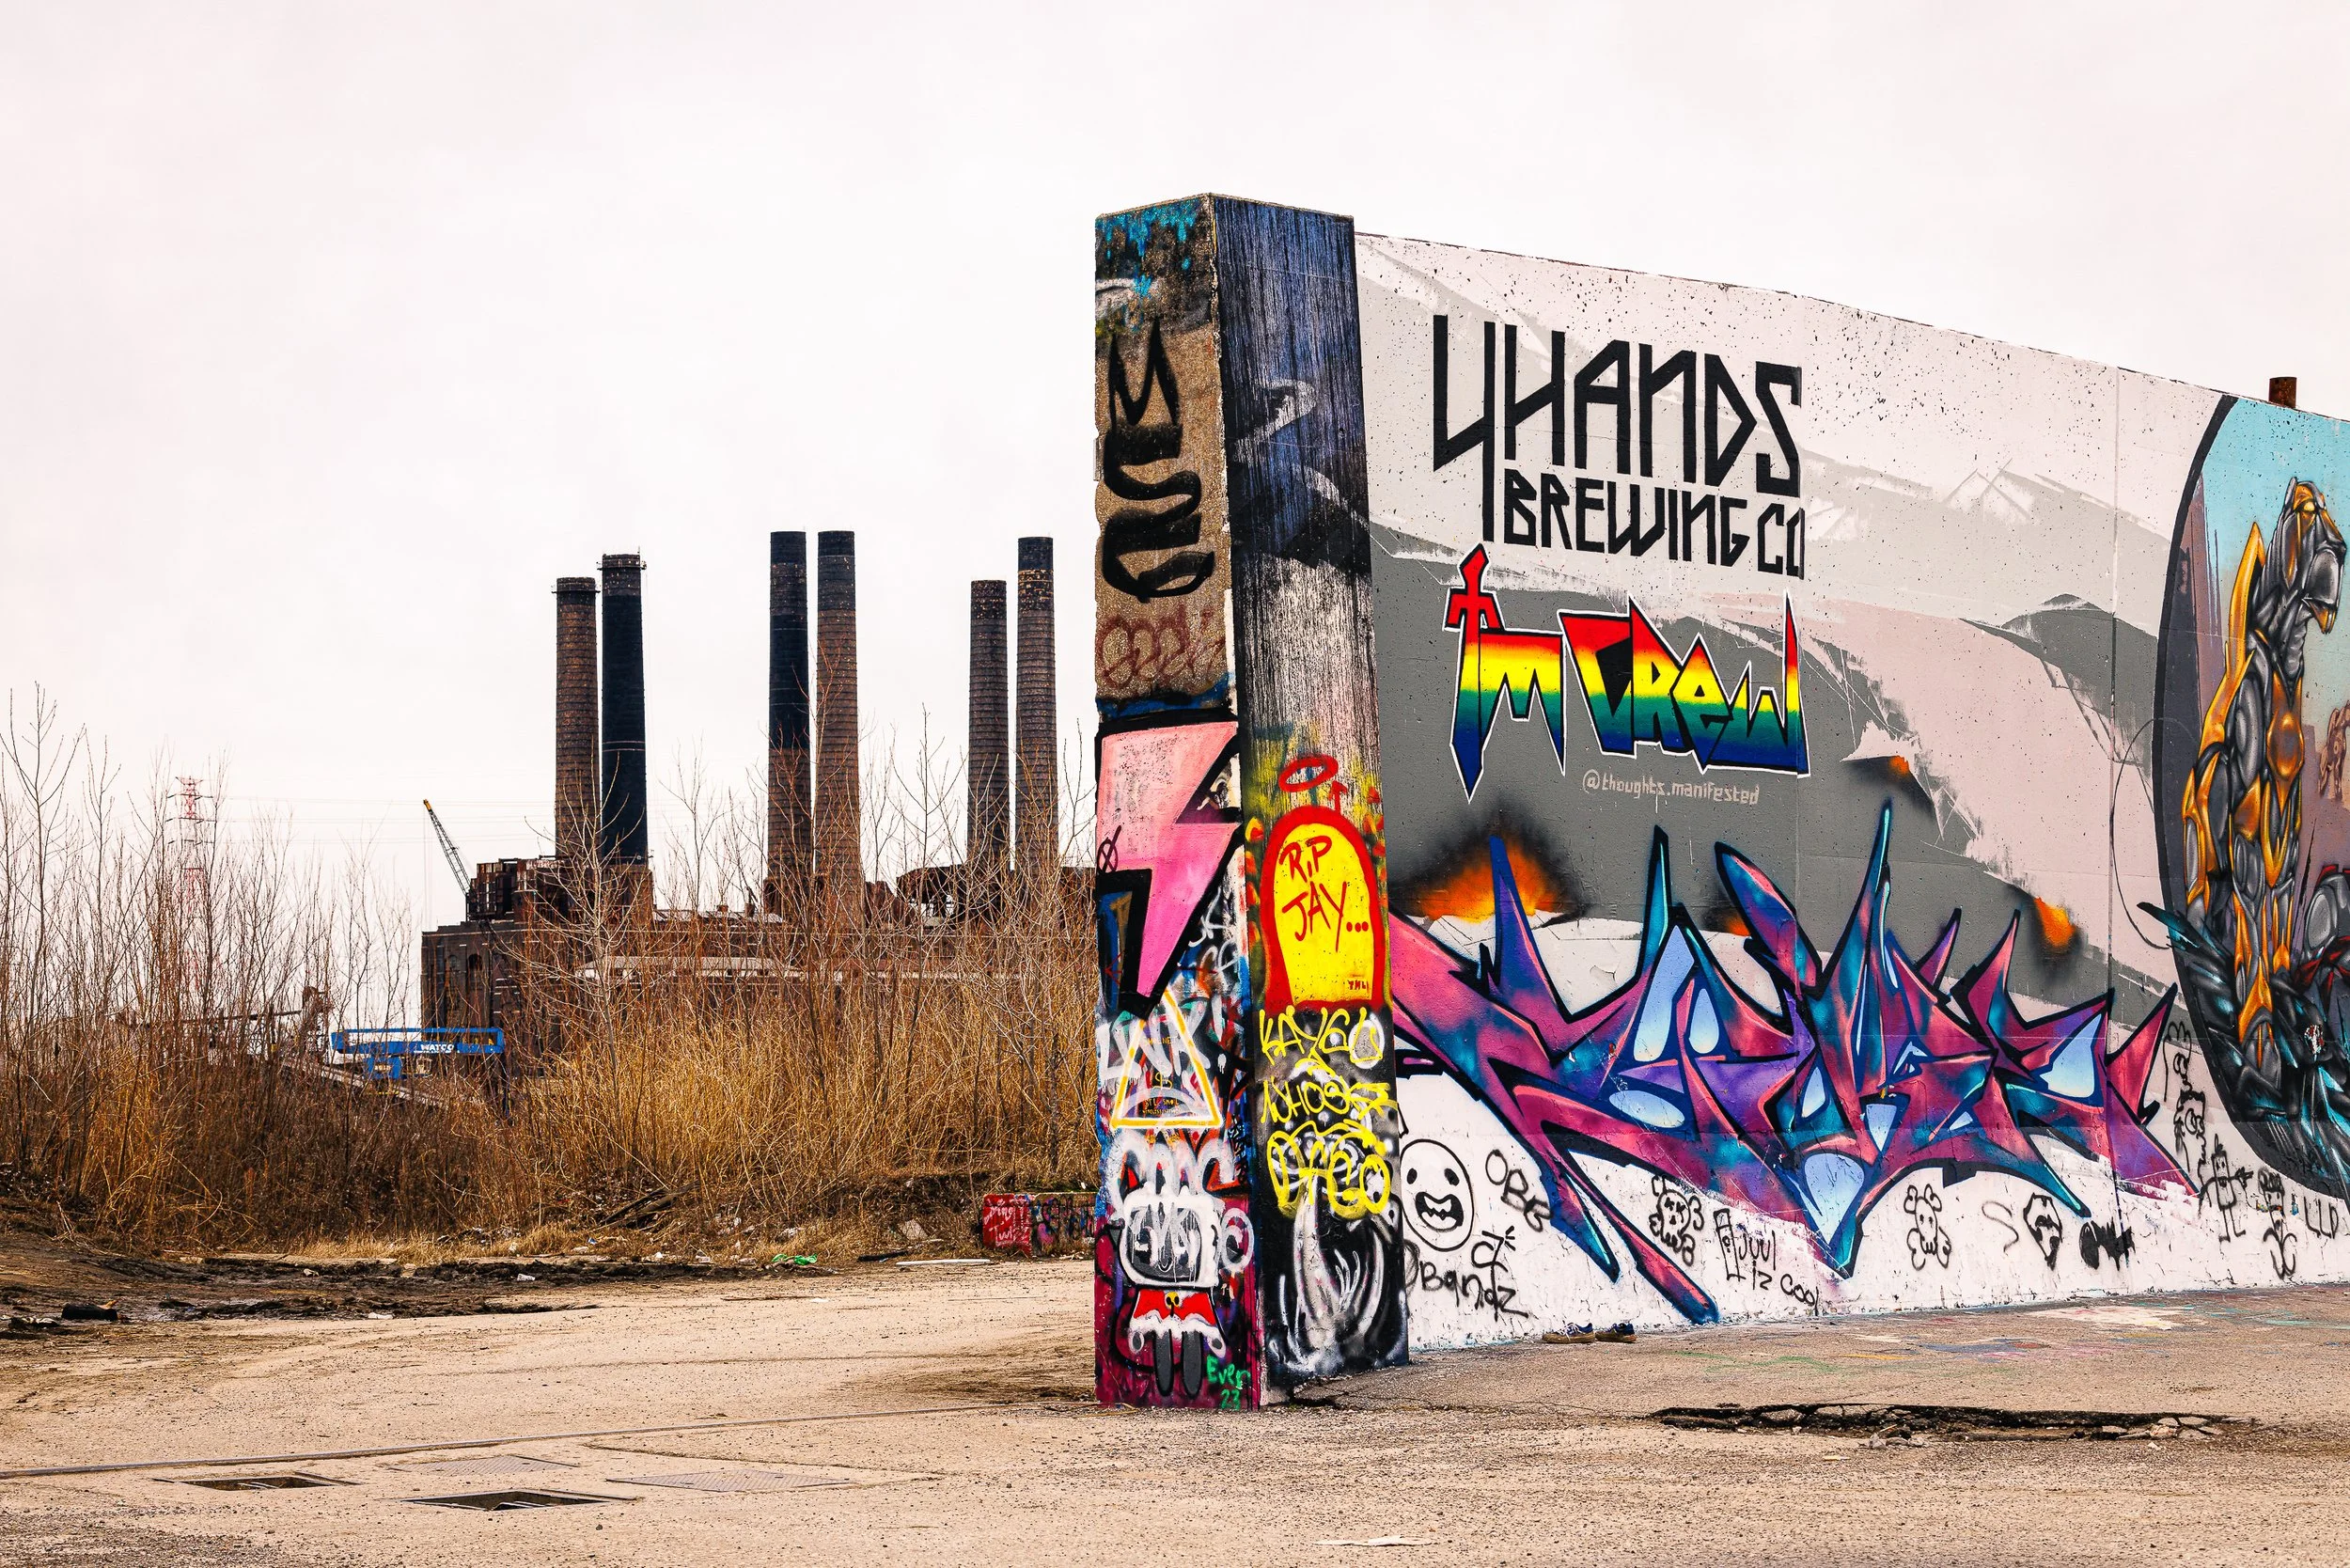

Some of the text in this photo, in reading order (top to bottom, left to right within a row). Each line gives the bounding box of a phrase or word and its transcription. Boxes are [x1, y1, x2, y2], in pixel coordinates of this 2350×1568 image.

[1504, 467, 1747, 568] BREWING
[1582, 768, 1760, 806] @thoughts.manifested
[420, 1043, 455, 1052] WATCO
